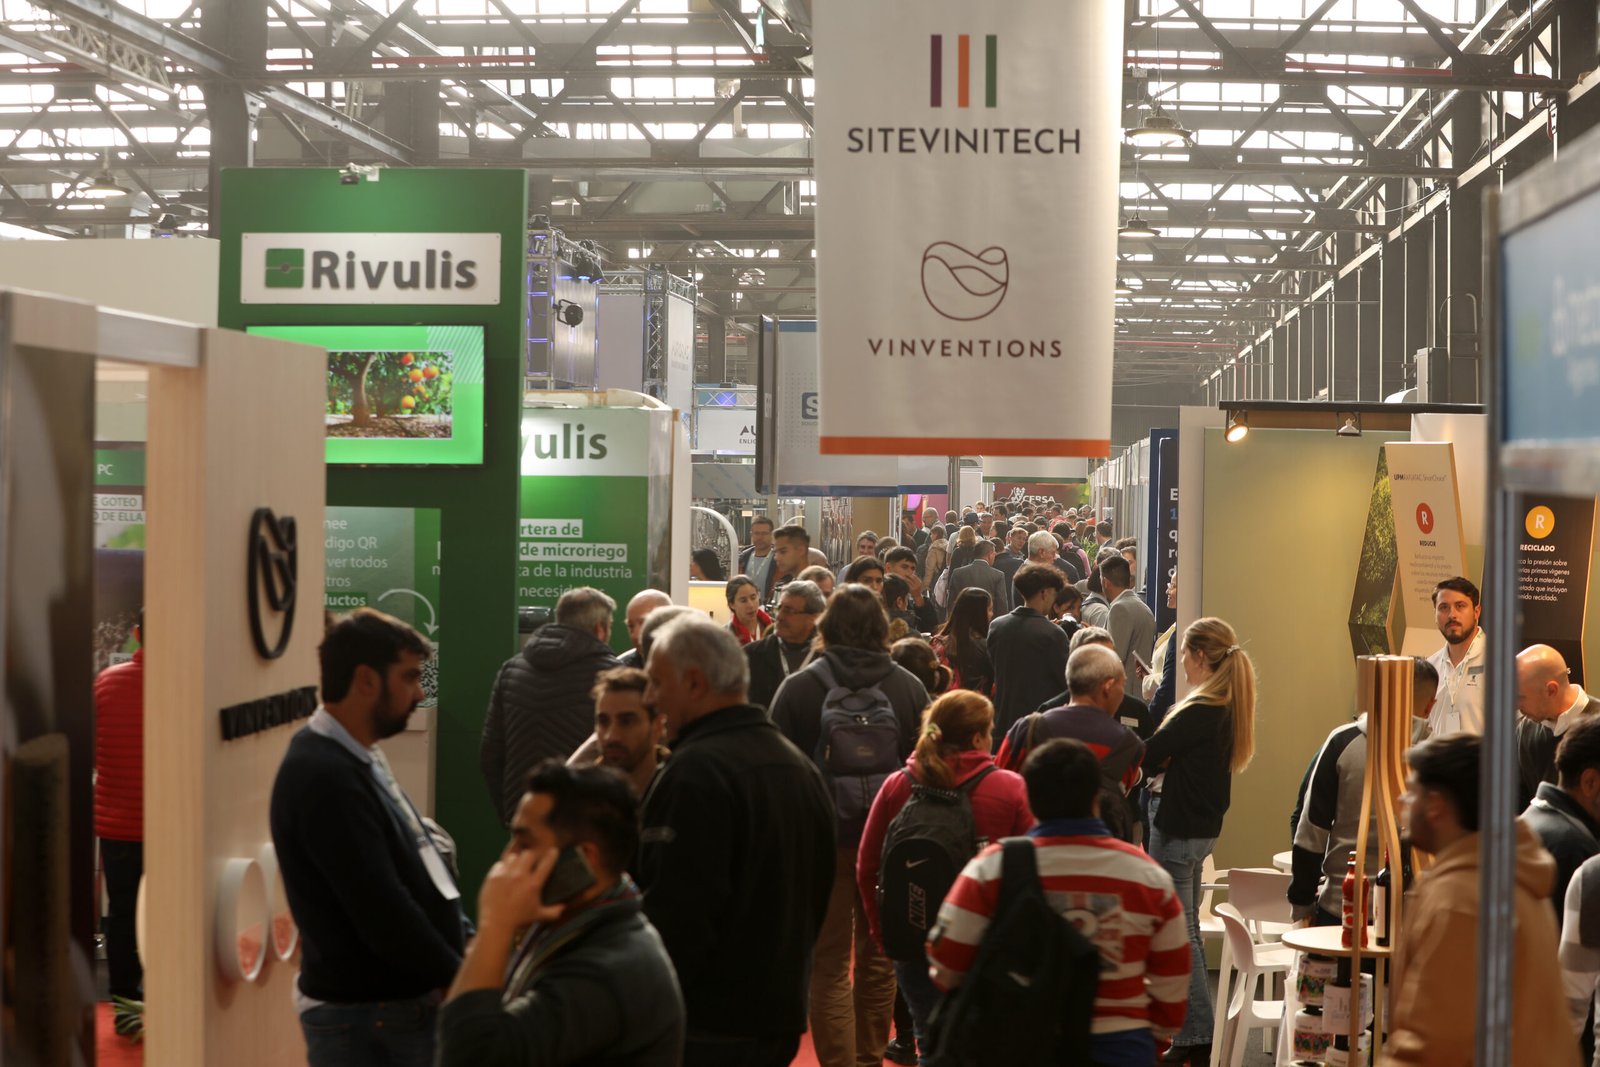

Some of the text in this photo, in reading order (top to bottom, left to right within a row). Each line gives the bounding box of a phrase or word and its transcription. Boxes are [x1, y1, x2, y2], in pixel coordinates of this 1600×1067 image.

[847, 127, 1081, 155] SITEVINITECH
[311, 249, 478, 290] Rivulis
[868, 338, 1062, 358] VINVENTIONS
[101, 497, 138, 507] GOTEO
[102, 511, 116, 521] DE
[118, 511, 144, 522] ELLA
[1421, 510, 1429, 526] R
[1535, 513, 1545, 529] R
[561, 522, 580, 536] de
[357, 536, 378, 551] QR
[1520, 544, 1556, 552] RECICLADO
[520, 543, 626, 560] de microriego
[327, 555, 388, 568] ver todos
[1552, 559, 1568, 567] sobre
[533, 563, 552, 577] de
[555, 563, 567, 577] la
[570, 564, 633, 579] industria
